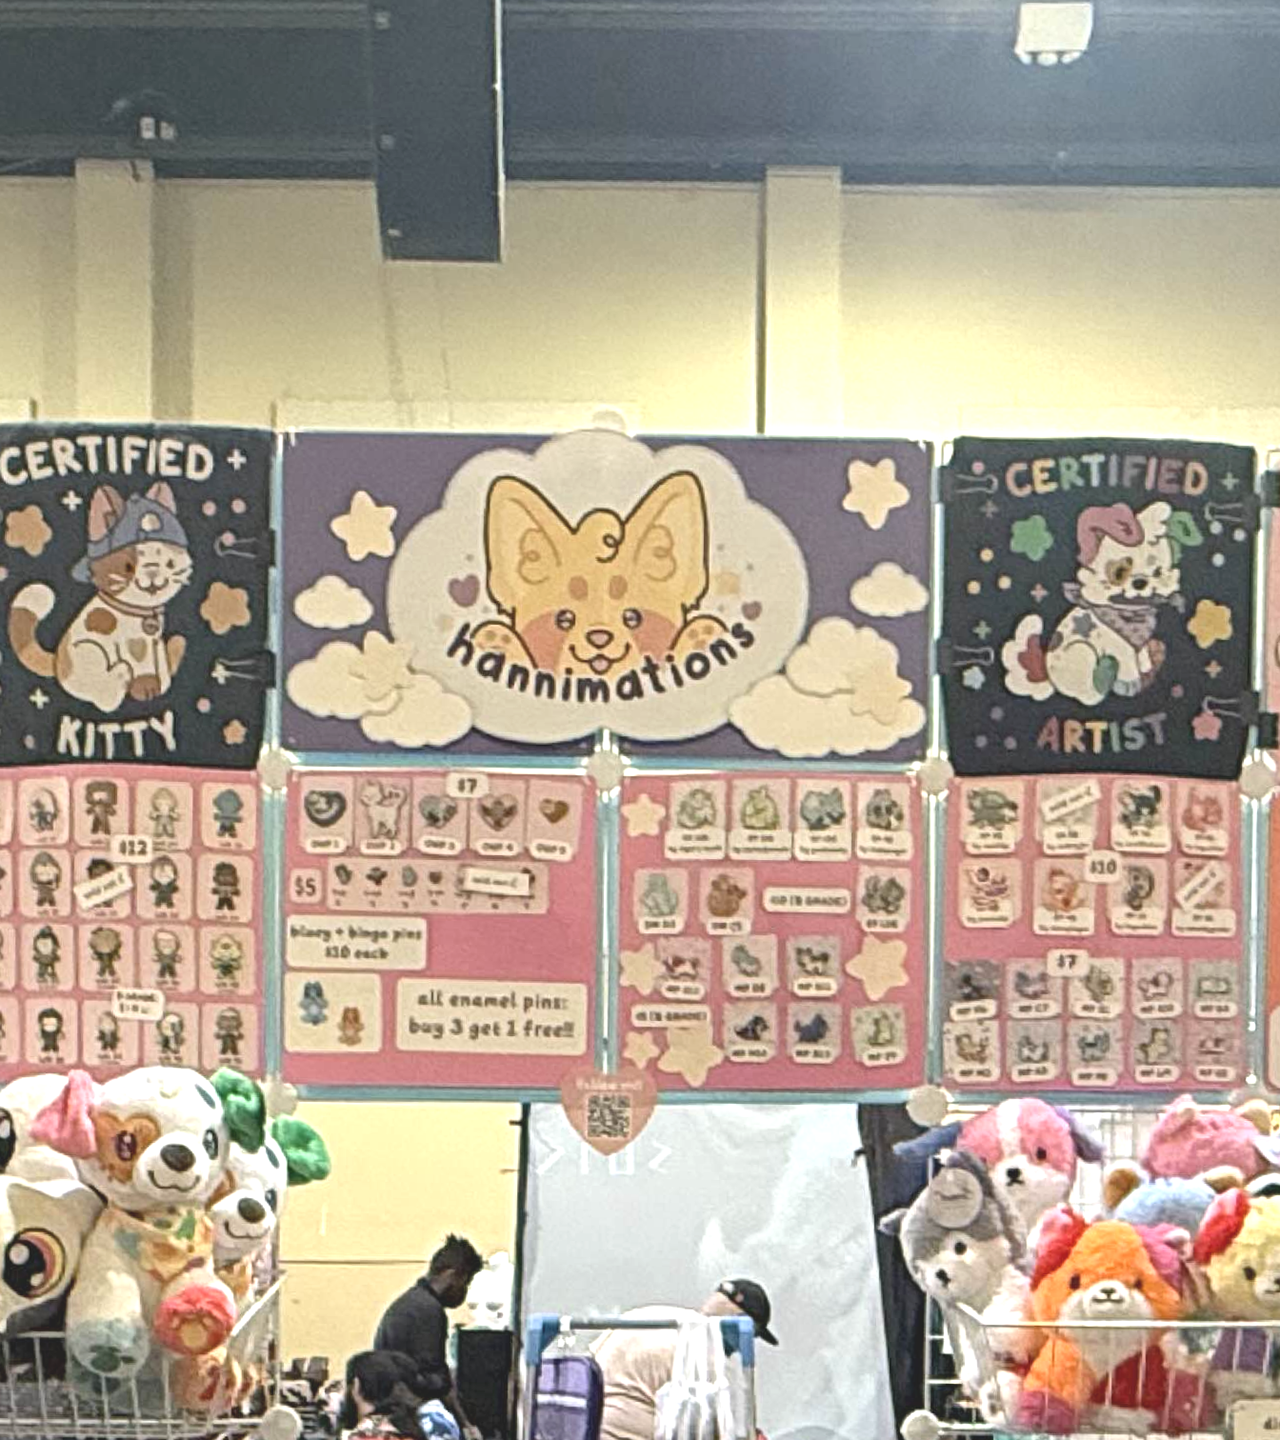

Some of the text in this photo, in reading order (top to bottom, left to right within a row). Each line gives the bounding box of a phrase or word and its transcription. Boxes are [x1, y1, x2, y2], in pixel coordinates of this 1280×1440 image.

[1006, 455, 1208, 497] CERTIFIED
[444, 620, 756, 703] hannimations
[57, 711, 176, 757] KITTY
[1037, 714, 1167, 754] ARTIST
[294, 876, 317, 898] $5
[418, 990, 443, 1009] all
[449, 991, 517, 1010] enamel
[409, 1018, 444, 1039] buy
[450, 1020, 464, 1036] 3
[469, 1020, 501, 1040] get
[506, 1020, 517, 1036] 1
